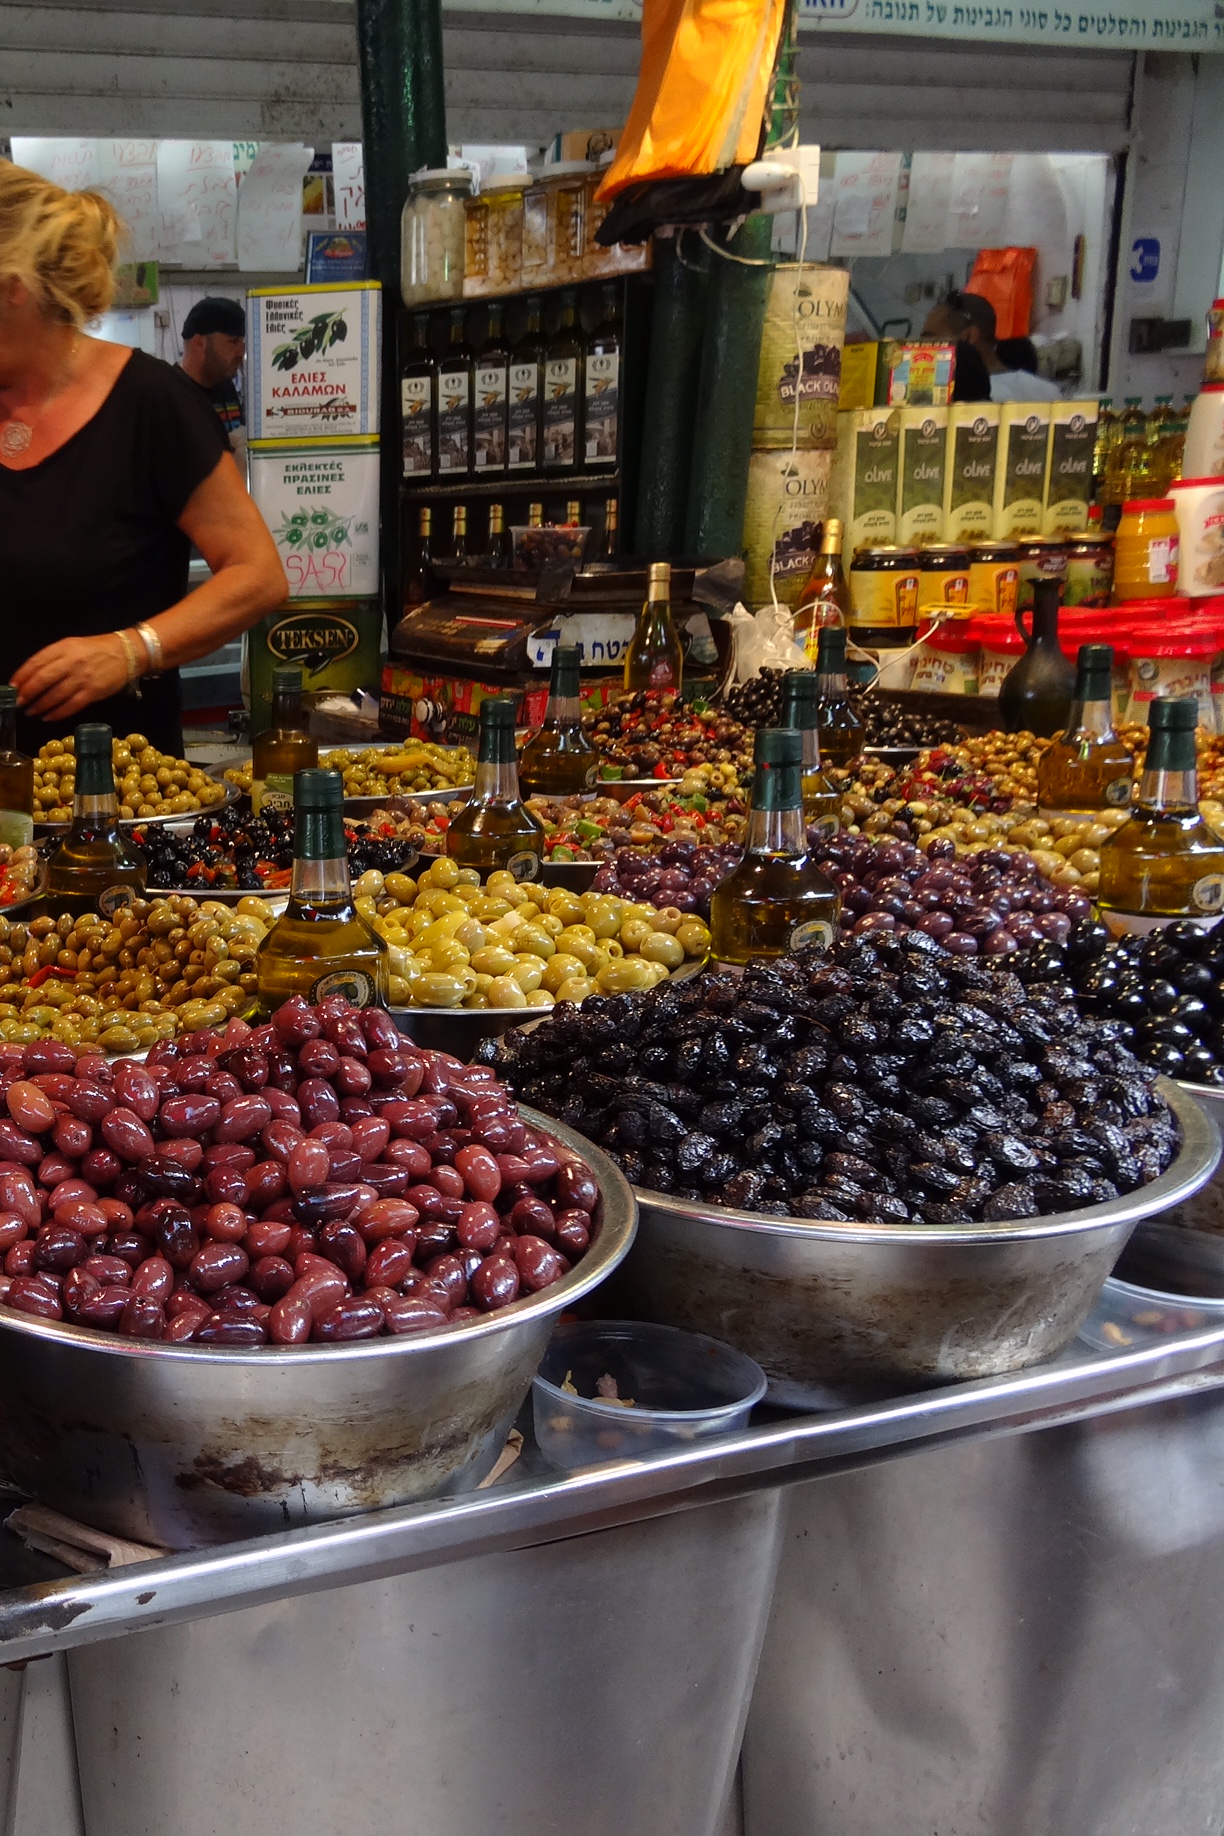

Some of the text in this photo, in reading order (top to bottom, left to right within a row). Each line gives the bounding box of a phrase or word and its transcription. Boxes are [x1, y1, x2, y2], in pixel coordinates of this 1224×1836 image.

[926, 2, 947, 25] של
[953, 5, 1013, 28] הגבינות
[1054, 9, 1072, 32] כל
[1078, 13, 1147, 36] והסלטים
[1152, 18, 1208, 39] הגבינות
[291, 372, 327, 384] ΕΛΙΕΣ
[272, 384, 346, 398] ΚΑΛΑΜΩΝ
[780, 380, 821, 399] BLACK
[276, 629, 349, 650] TEKSEN
